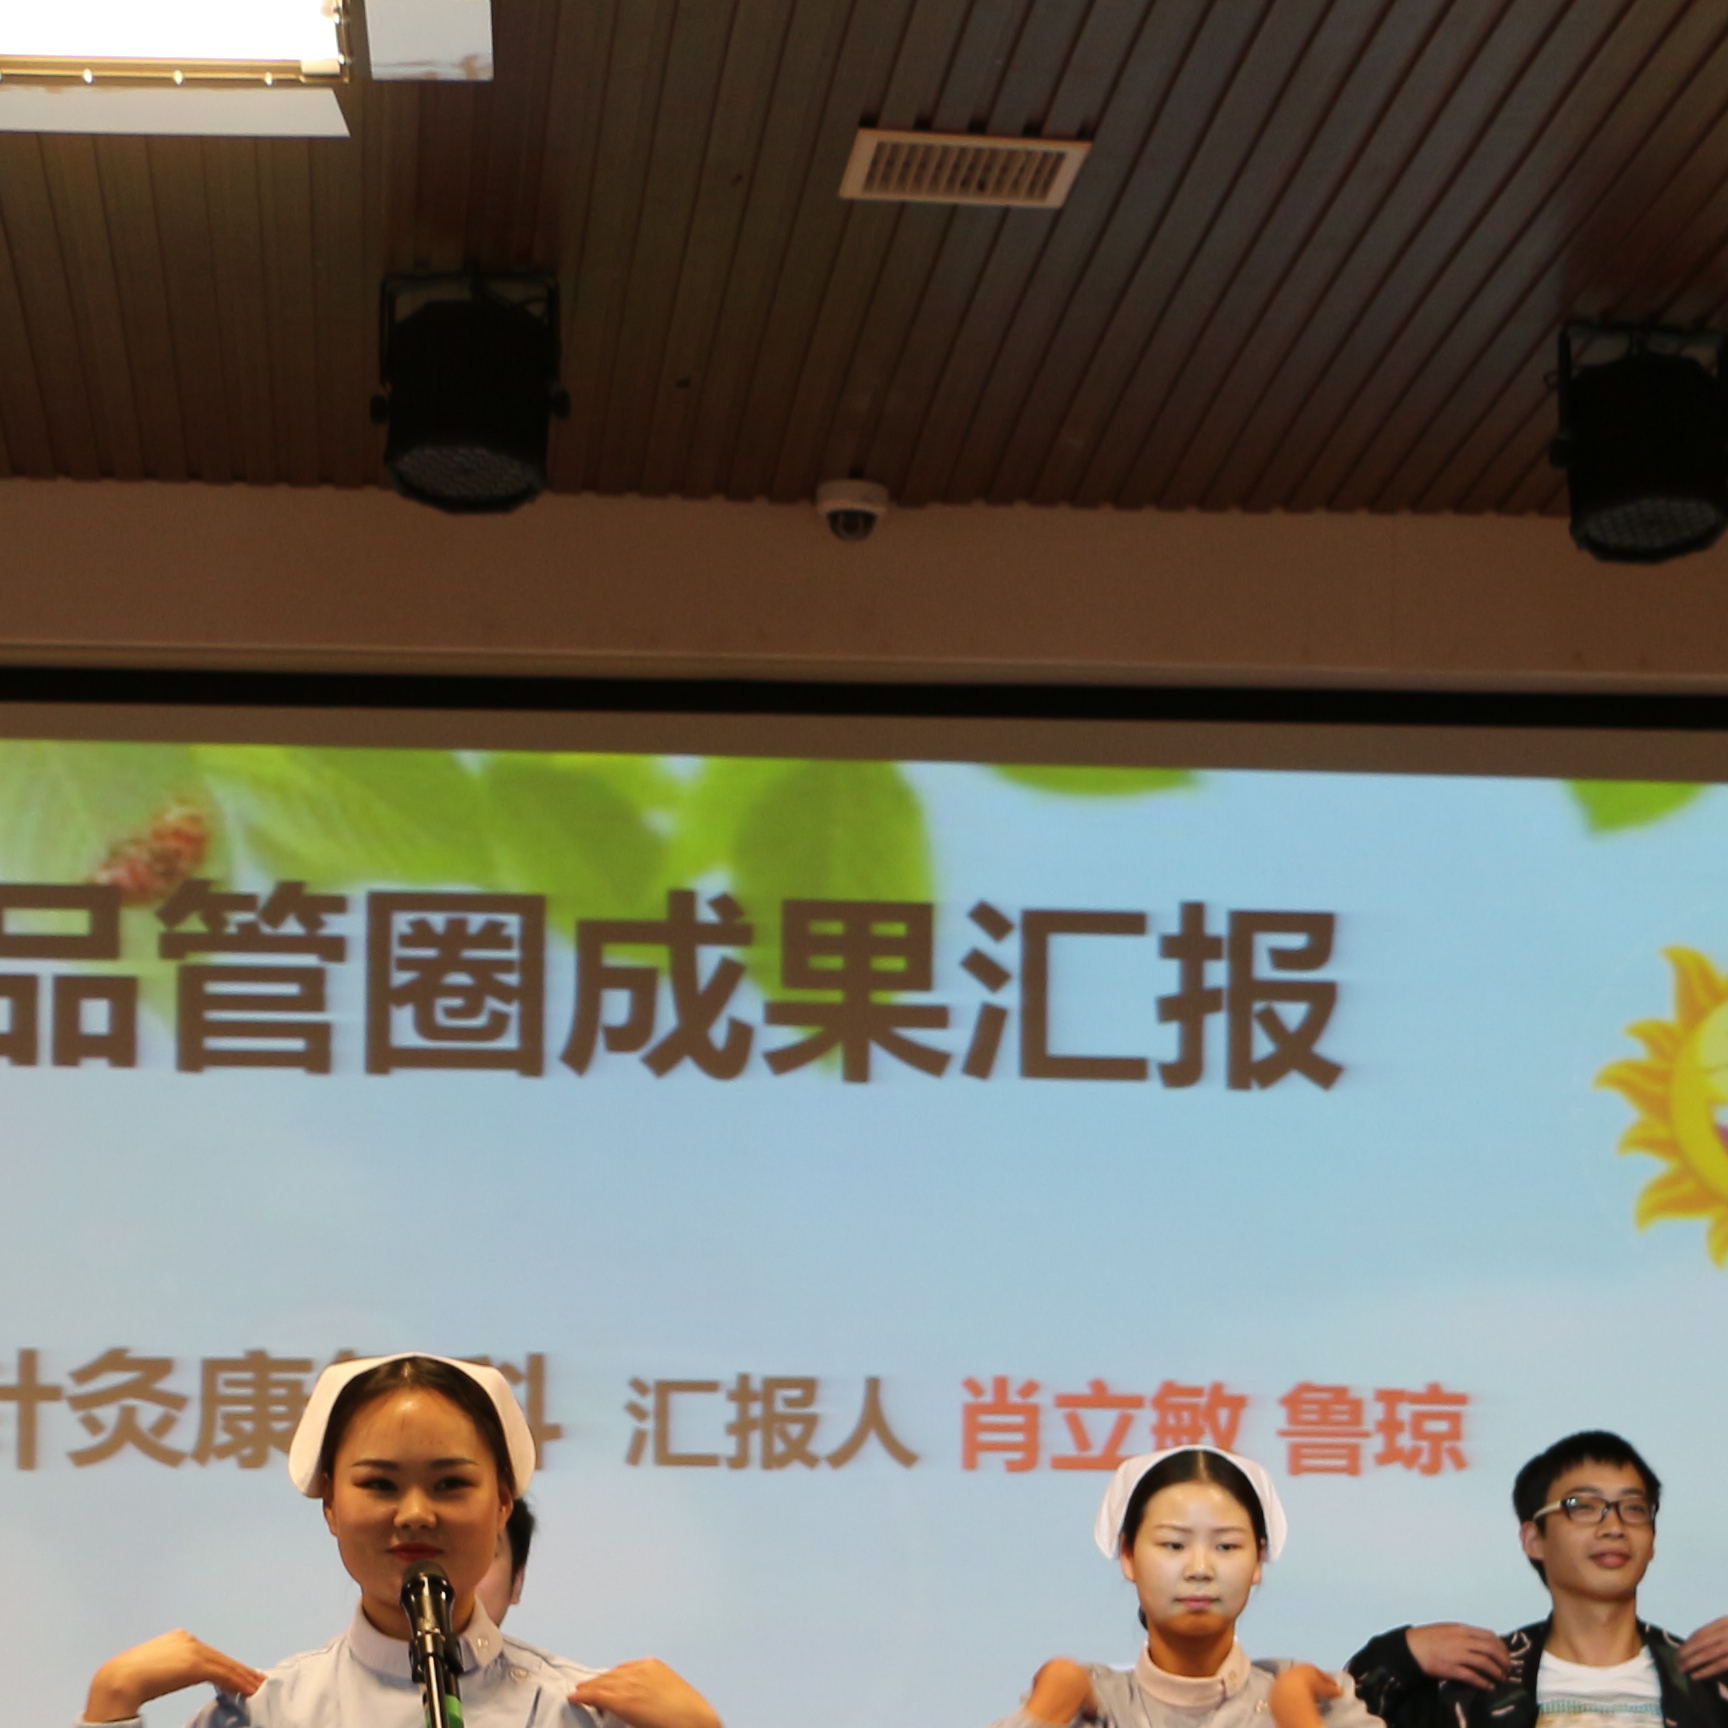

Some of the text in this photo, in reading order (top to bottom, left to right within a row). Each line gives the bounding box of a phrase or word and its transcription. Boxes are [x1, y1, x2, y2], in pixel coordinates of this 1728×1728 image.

[625, 1373, 920, 1471] 汇报人
[961, 1375, 1250, 1474] 肖立敏
[1276, 1382, 1470, 1477] 鲁琼
